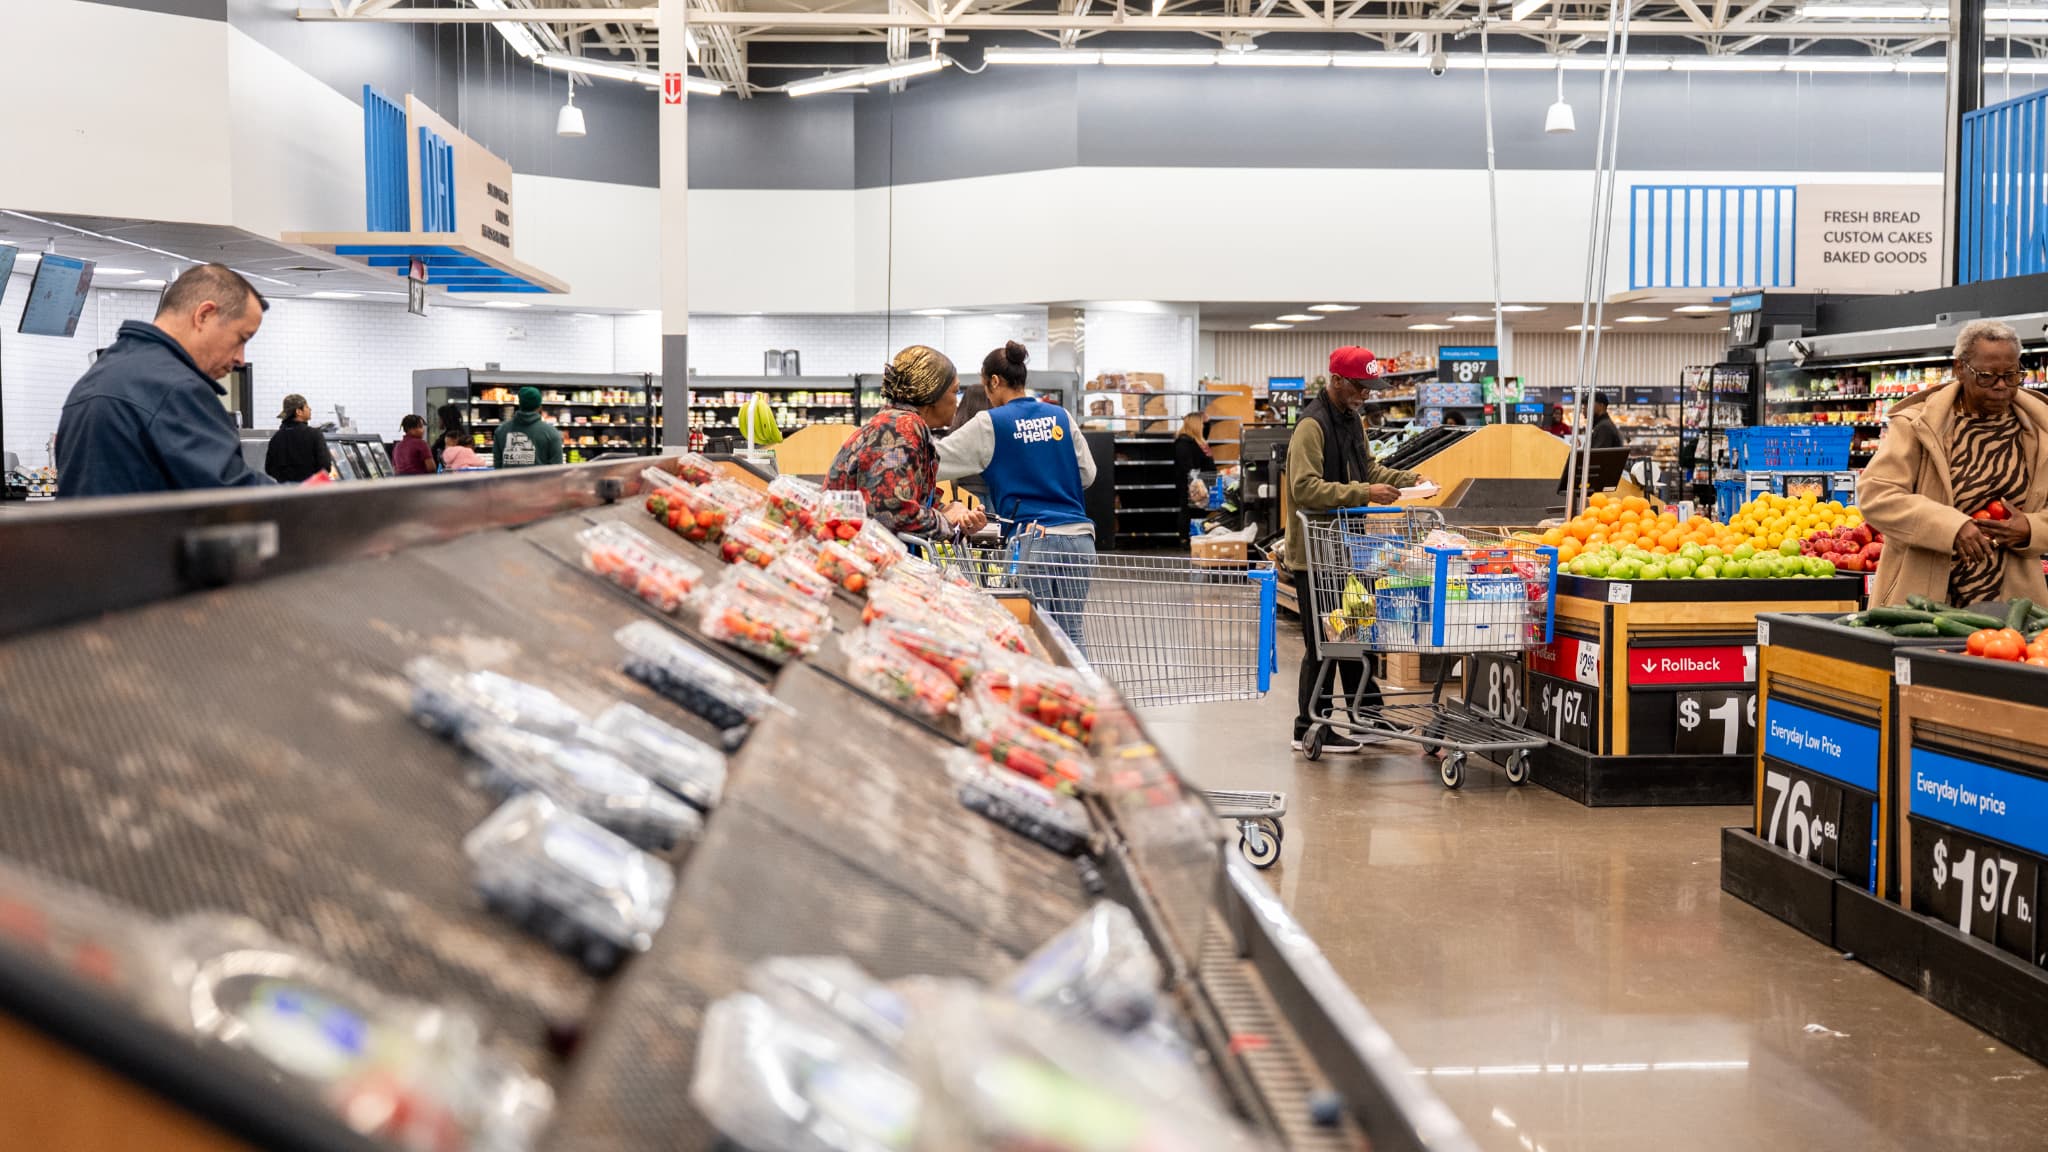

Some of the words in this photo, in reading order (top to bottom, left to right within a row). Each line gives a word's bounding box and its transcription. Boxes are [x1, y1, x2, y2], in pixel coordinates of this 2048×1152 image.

[1824, 211, 1869, 223] FRESH
[1873, 211, 1920, 223] BREAD
[1823, 231, 1884, 243] CUSTOM
[1888, 231, 1933, 244] CAKES
[1823, 251, 1870, 263] BAKED
[1874, 251, 1928, 264] GOODS
[1015, 415, 1057, 432] Happy
[1013, 431, 1023, 440] to
[1022, 427, 1053, 444] Help
[1470, 581, 1523, 599] Sparkle
[1661, 657, 1721, 672] Rollback
[1771, 719, 1804, 750] Everyday
[1804, 730, 1820, 751] Low
[1821, 736, 1841, 758] Price
[1916, 771, 1959, 807] Everyday
[1959, 784, 1978, 808] low
[1979, 792, 2006, 816] price
[1824, 820, 1837, 841] ea.
[2017, 895, 2032, 923] lb.
